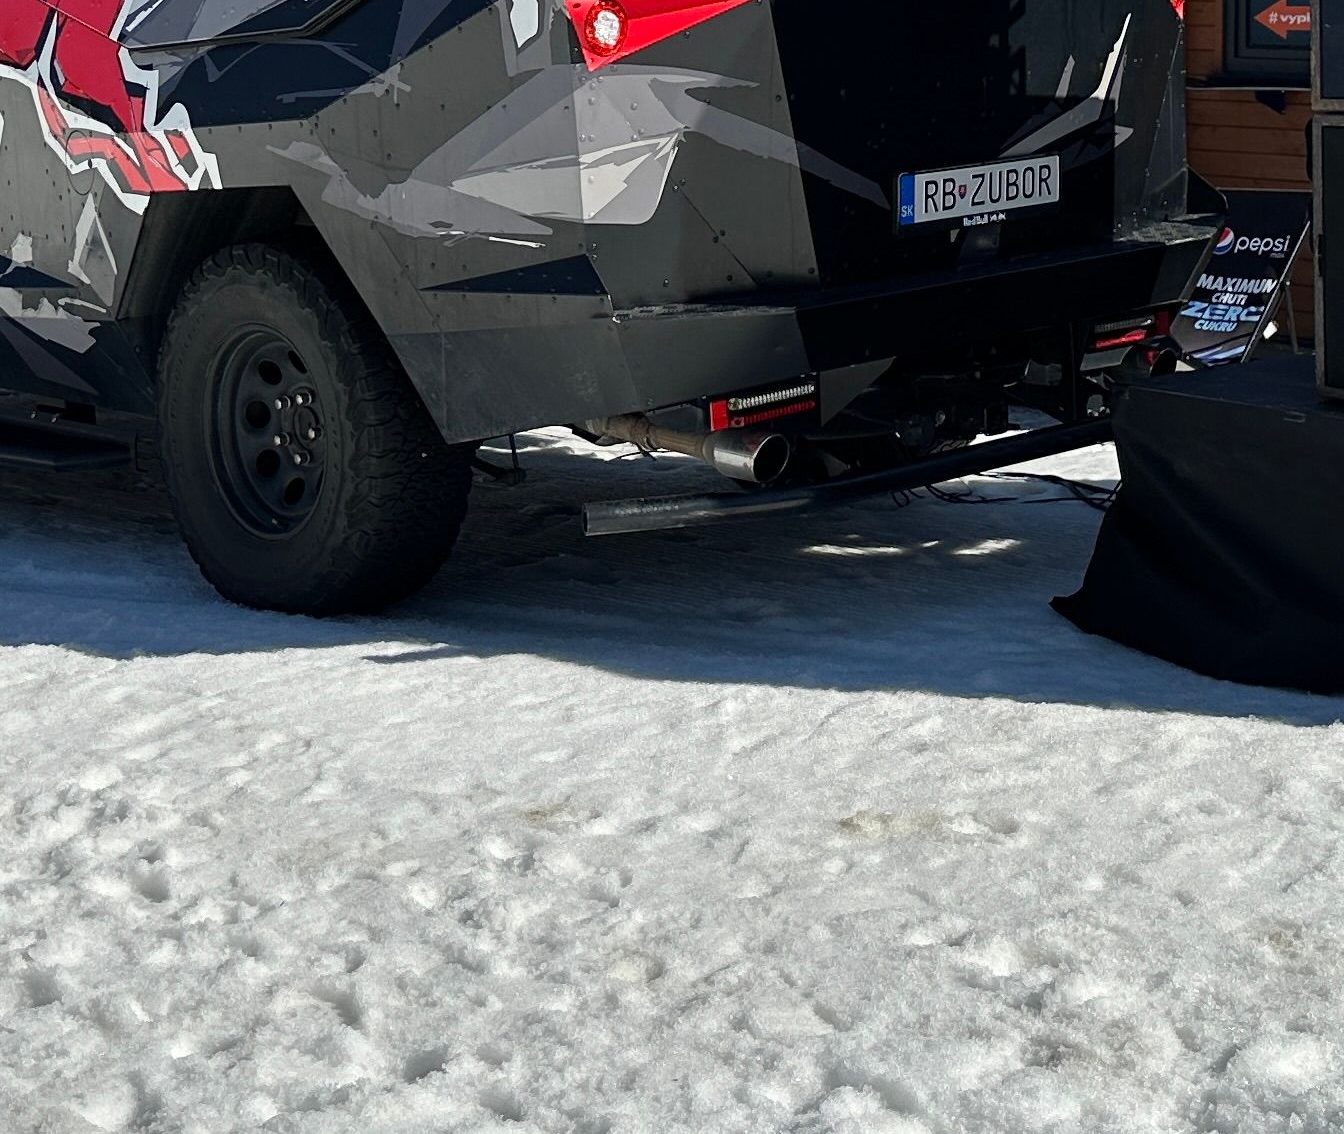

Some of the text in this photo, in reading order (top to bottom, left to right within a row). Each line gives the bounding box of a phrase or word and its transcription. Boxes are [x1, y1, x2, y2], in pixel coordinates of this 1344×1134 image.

[924, 164, 1052, 213] RB ZUBOR
[901, 205, 914, 217] SK
[1234, 235, 1291, 255] pepsi
[1194, 319, 1238, 332] CUKRU
